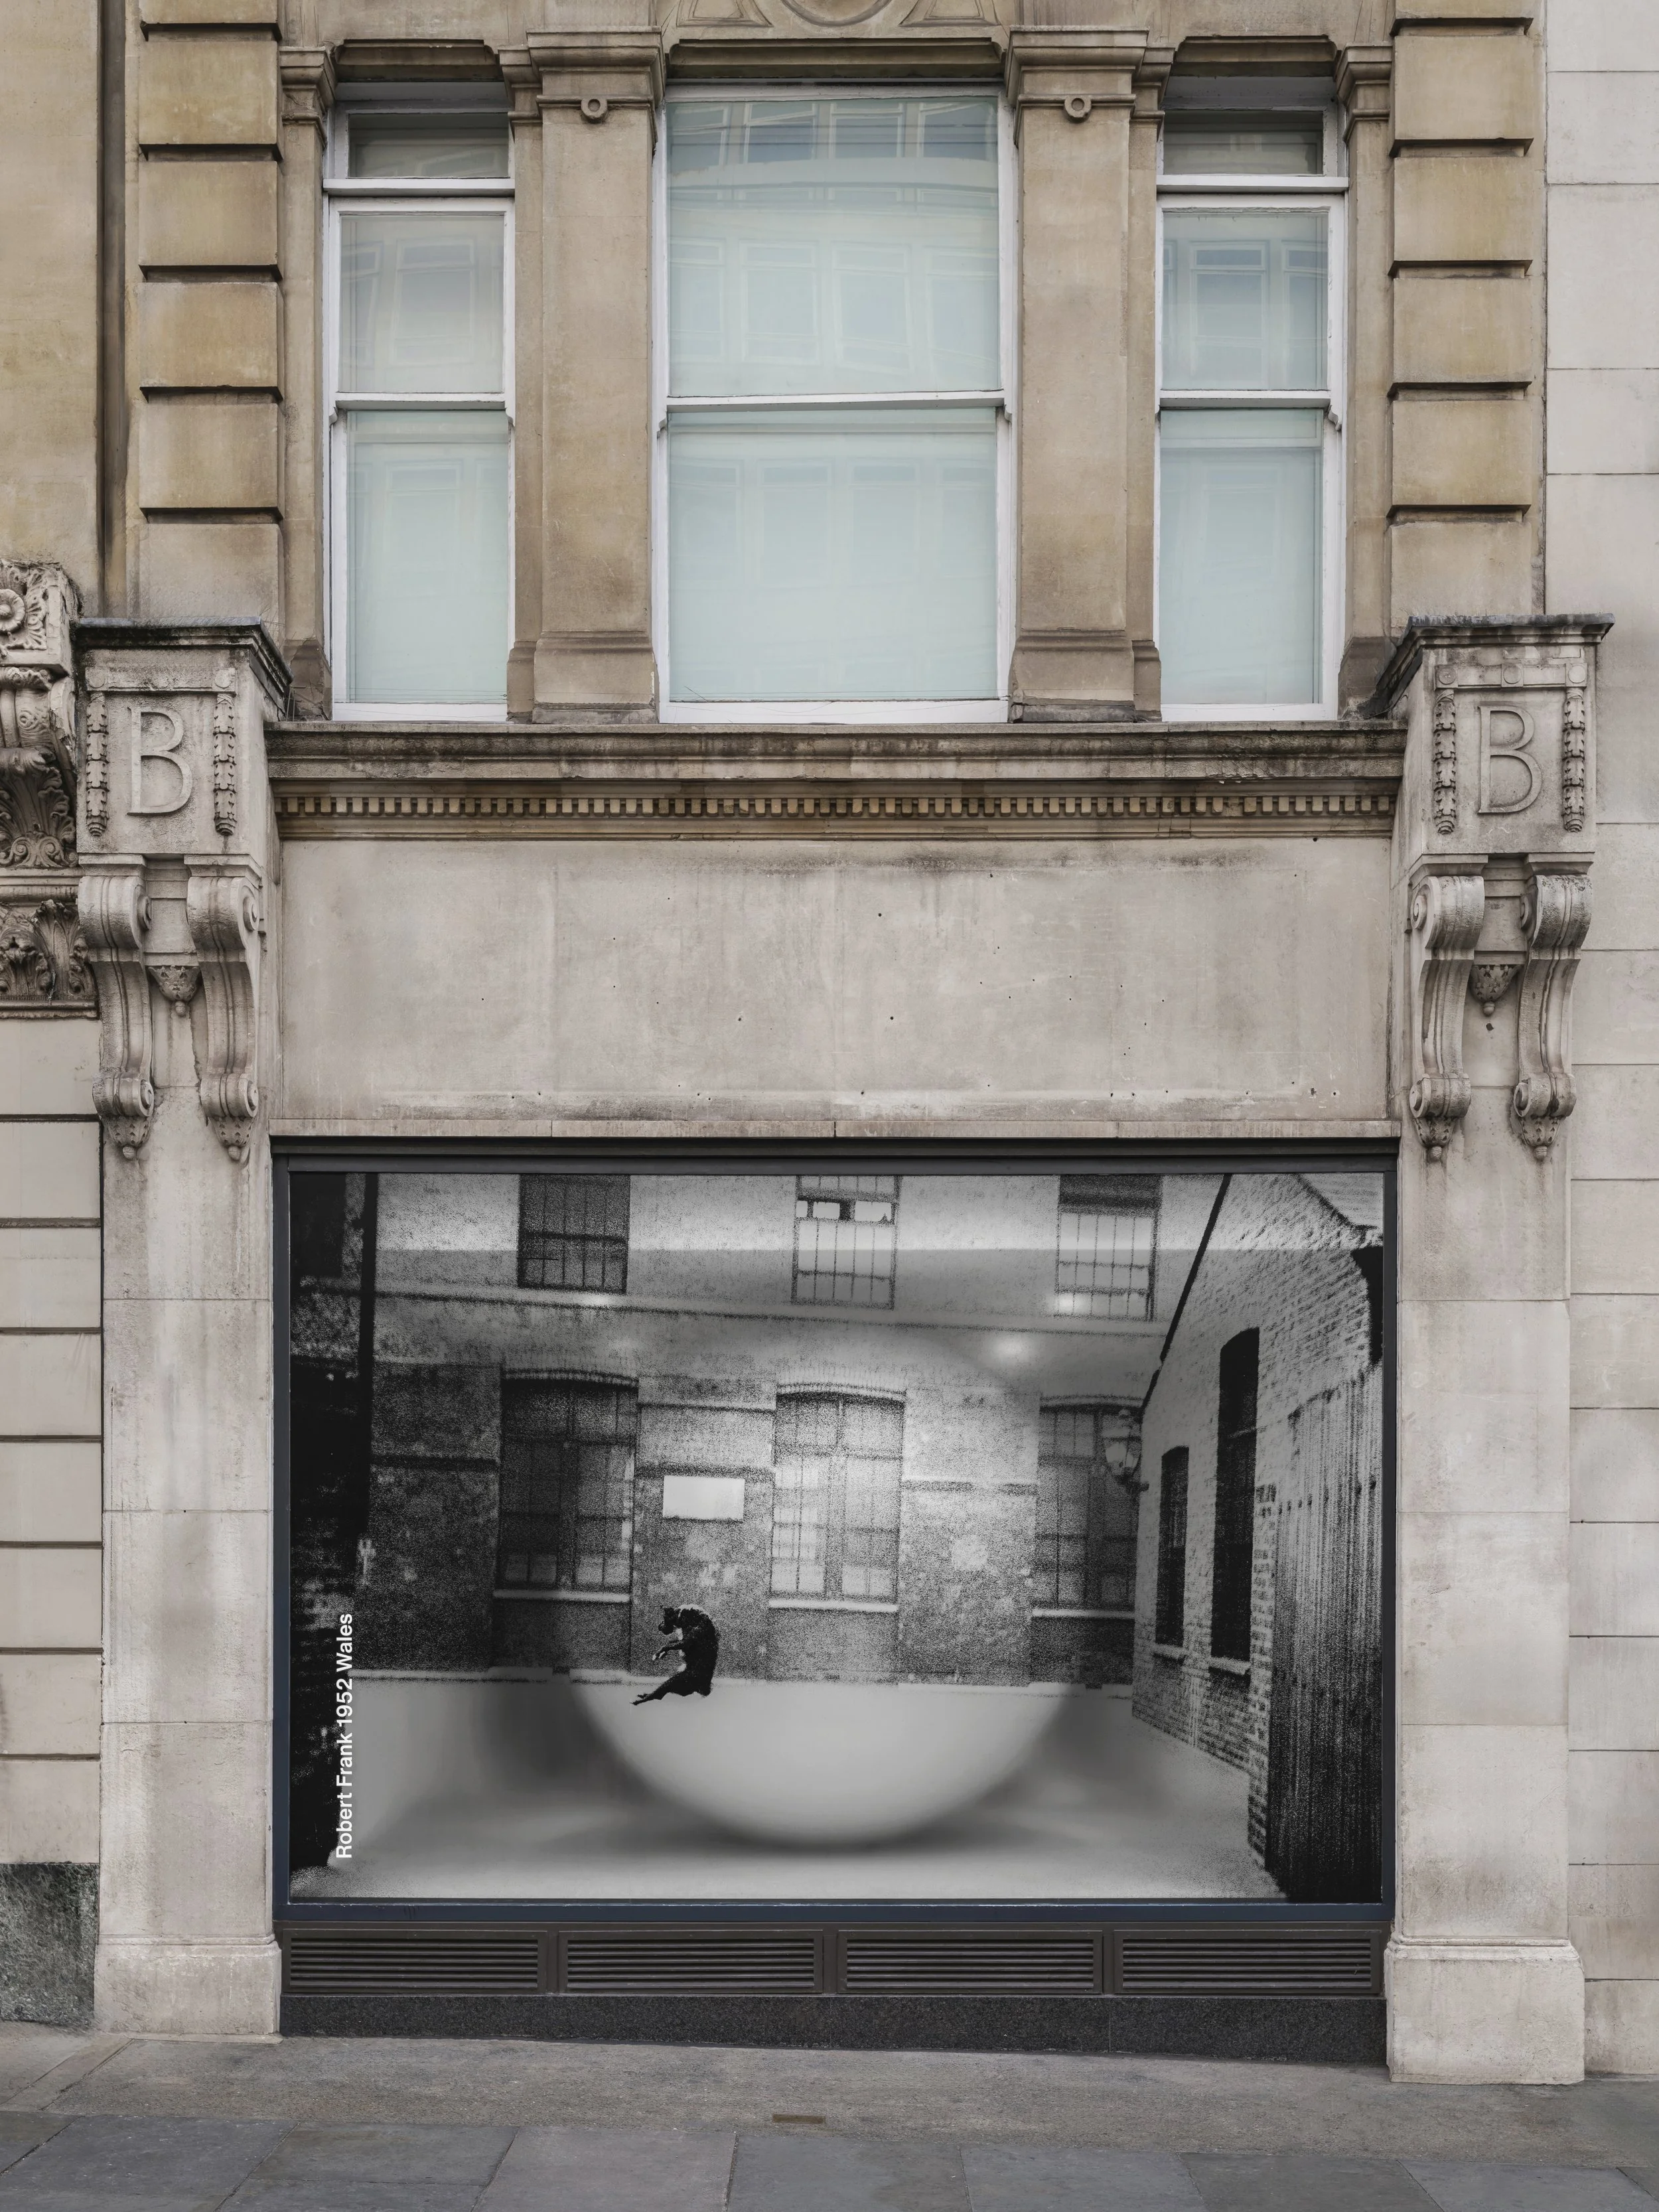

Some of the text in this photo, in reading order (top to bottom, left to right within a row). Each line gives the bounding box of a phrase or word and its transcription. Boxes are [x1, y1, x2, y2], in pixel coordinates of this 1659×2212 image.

[127, 706, 193, 816] B
[1477, 705, 1543, 815] B
[336, 1613, 352, 1858] Robert Frank 1952 Wales
